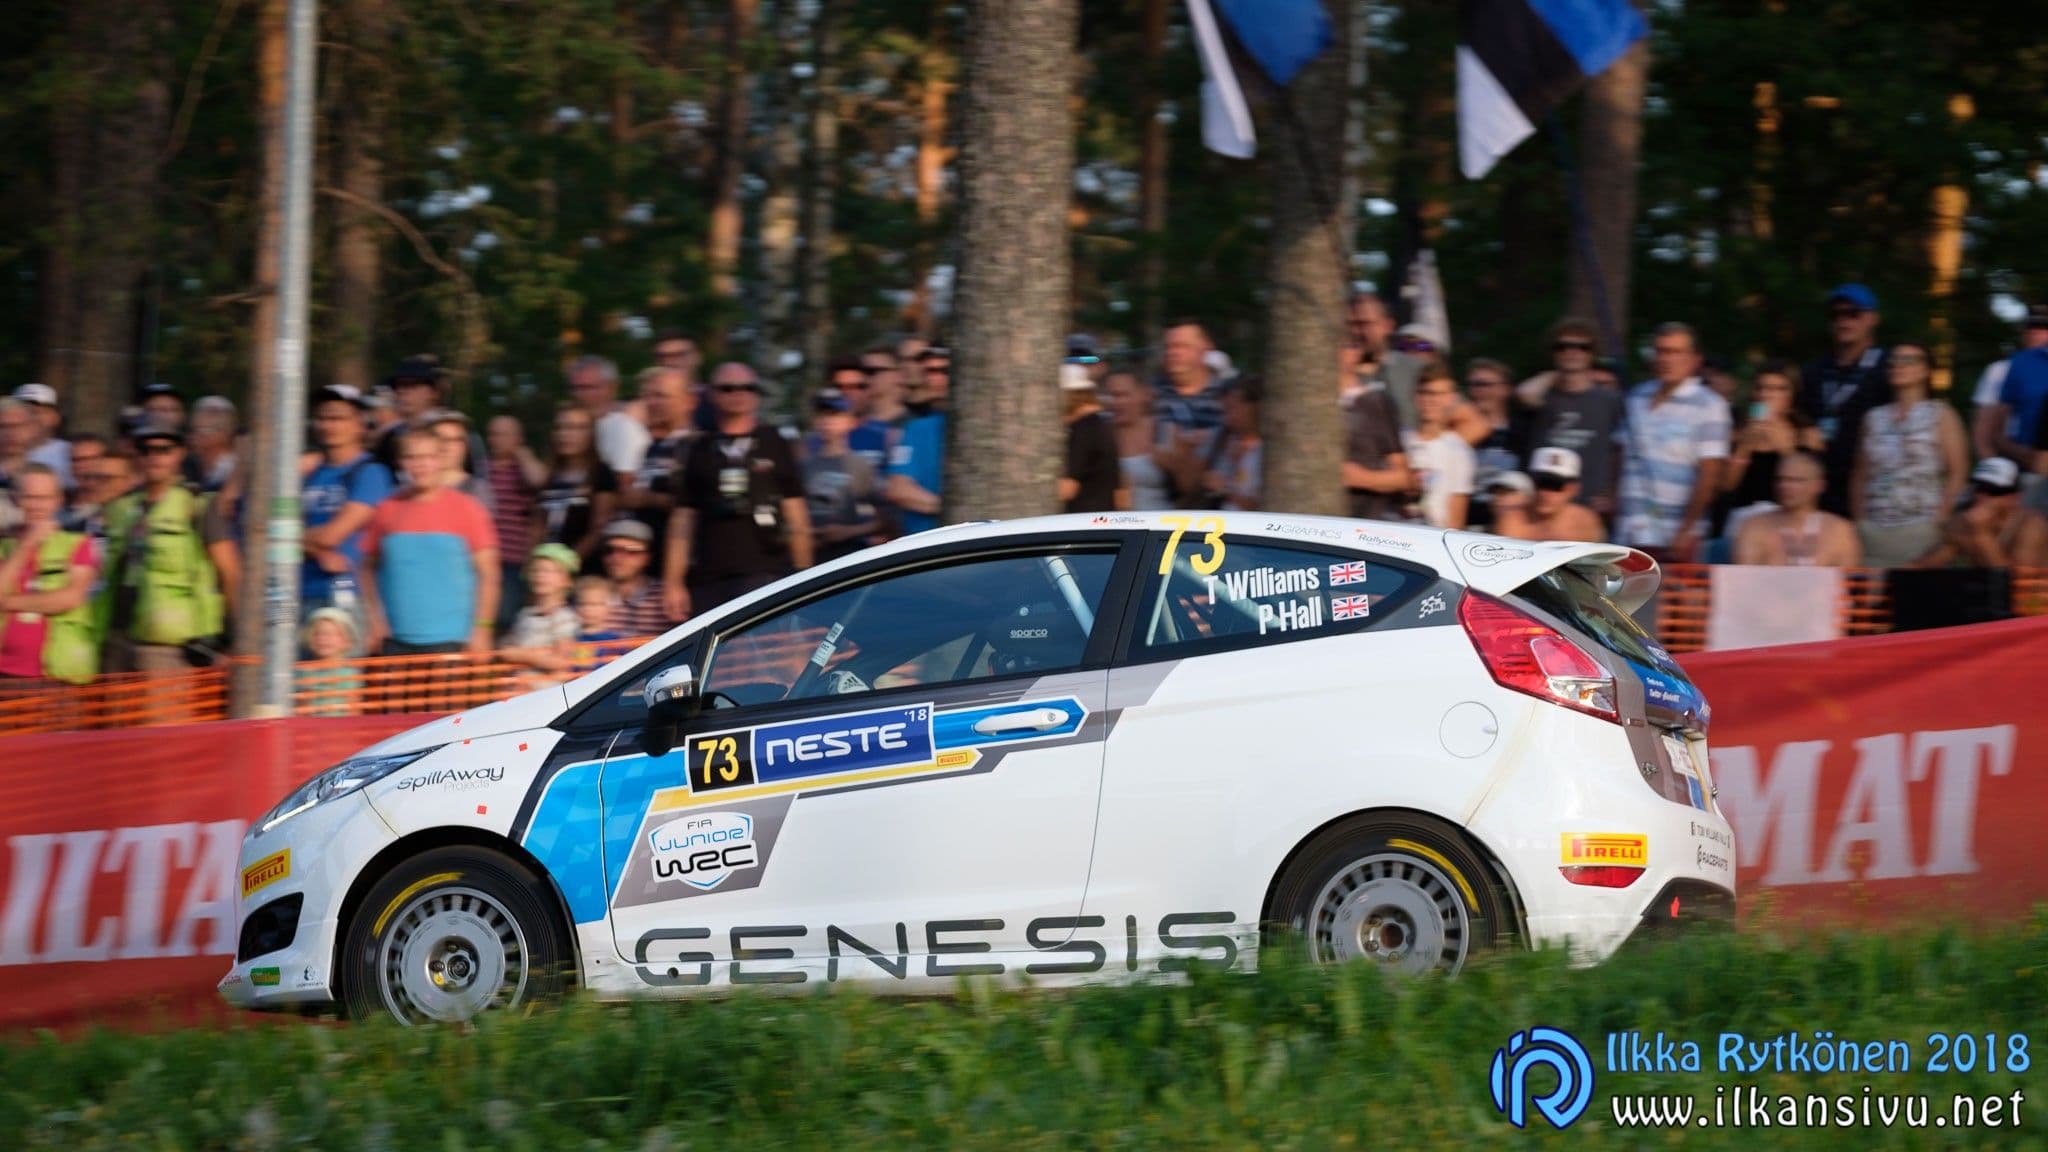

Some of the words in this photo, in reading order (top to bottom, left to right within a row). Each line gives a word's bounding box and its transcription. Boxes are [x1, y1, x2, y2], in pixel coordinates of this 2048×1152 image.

[1158, 516, 1228, 576] 73
[1203, 574, 1219, 605] T
[1225, 566, 1321, 602] Williams
[1258, 603, 1274, 635] P
[1279, 596, 1323, 632] Hall
[697, 736, 740, 784] 73
[766, 722, 908, 766] NESTE
[659, 828, 744, 851] JUNIOR
[687, 819, 712, 830] FIA
[656, 845, 754, 877] WRC
[1572, 838, 1642, 859] PIRELLI
[244, 855, 285, 892] PIRELLI
[635, 910, 1238, 987] GENESIS
